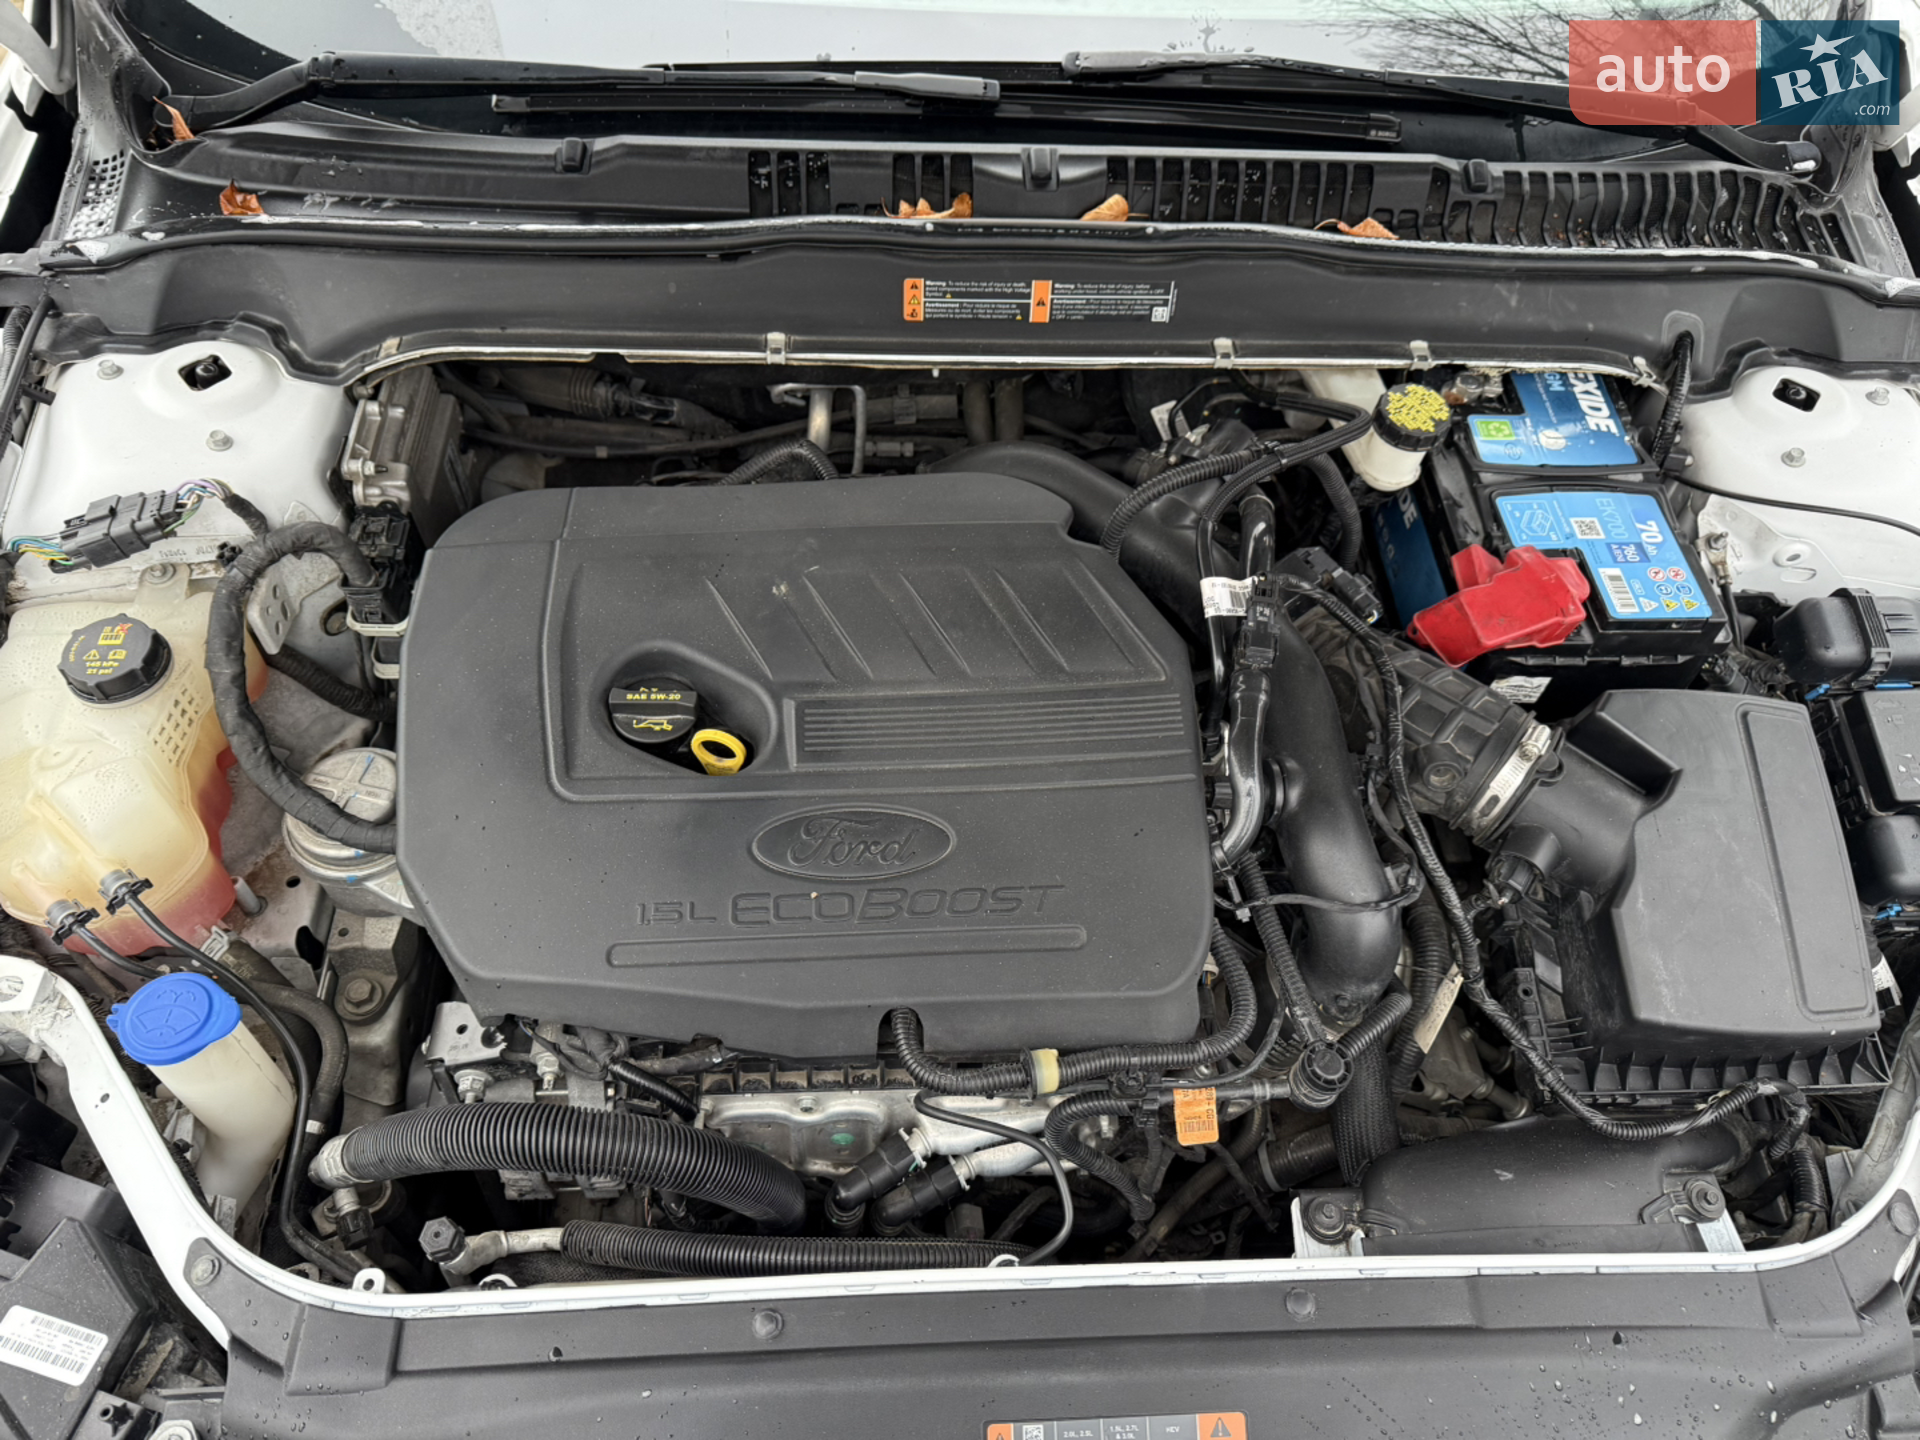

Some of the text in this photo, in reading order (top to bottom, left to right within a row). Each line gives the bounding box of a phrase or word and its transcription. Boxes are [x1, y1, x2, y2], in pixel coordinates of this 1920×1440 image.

[1567, 373, 1619, 434] EXIDE
[1595, 498, 1629, 539] EK700
[1635, 520, 1663, 544] 70
[1621, 544, 1640, 563] 760
[788, 816, 917, 867] Ford
